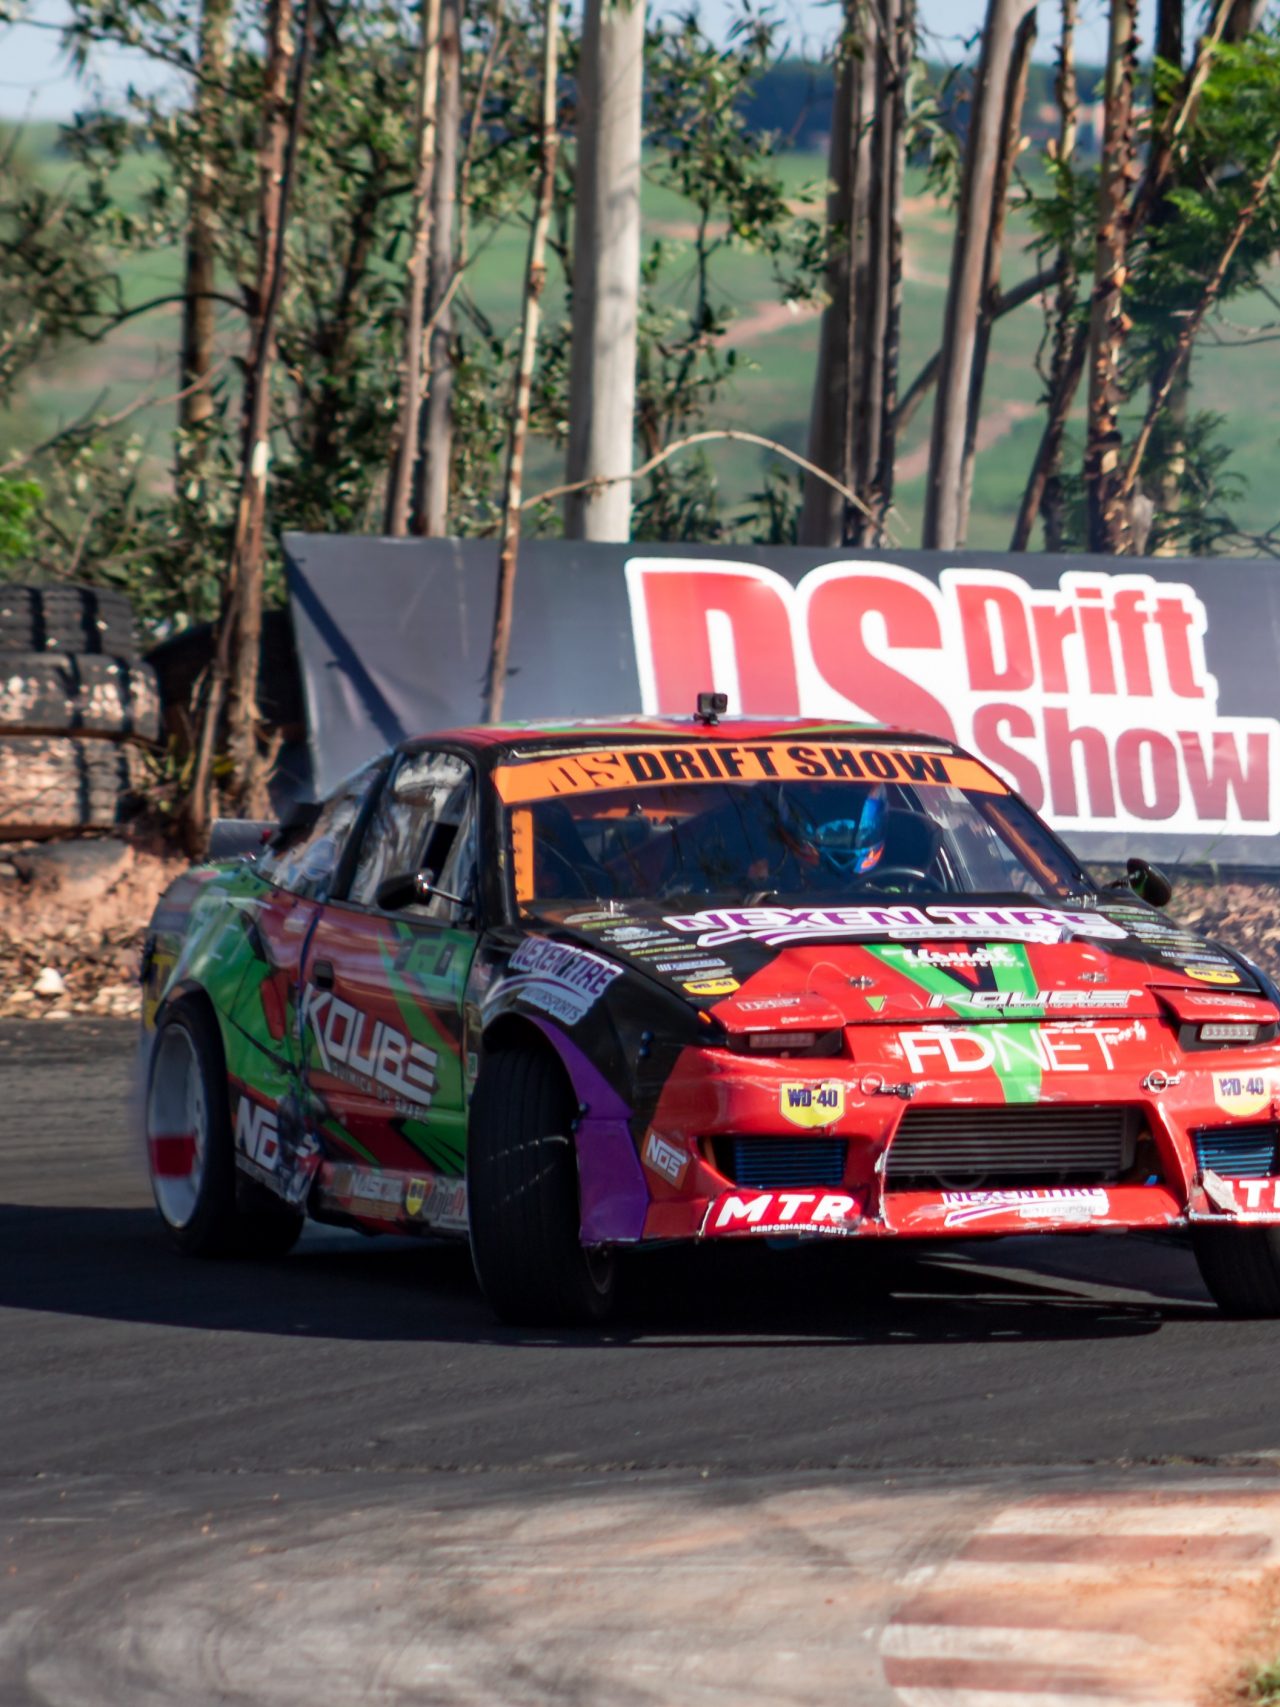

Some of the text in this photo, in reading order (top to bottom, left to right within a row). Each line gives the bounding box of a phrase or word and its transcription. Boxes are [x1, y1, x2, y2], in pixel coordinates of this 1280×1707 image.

[642, 570, 958, 744] DS
[955, 583, 1205, 699] Drift
[787, 746, 953, 785] SHOW
[971, 702, 1270, 822] Show
[664, 907, 928, 932] NEXEN
[928, 906, 1116, 928] TIRE
[510, 938, 573, 977] NEXEN
[564, 952, 620, 997] TIRE
[301, 982, 439, 1107] KOUBE
[714, 1194, 855, 1228] MTR
[818, 1225, 848, 1236] PARTS
